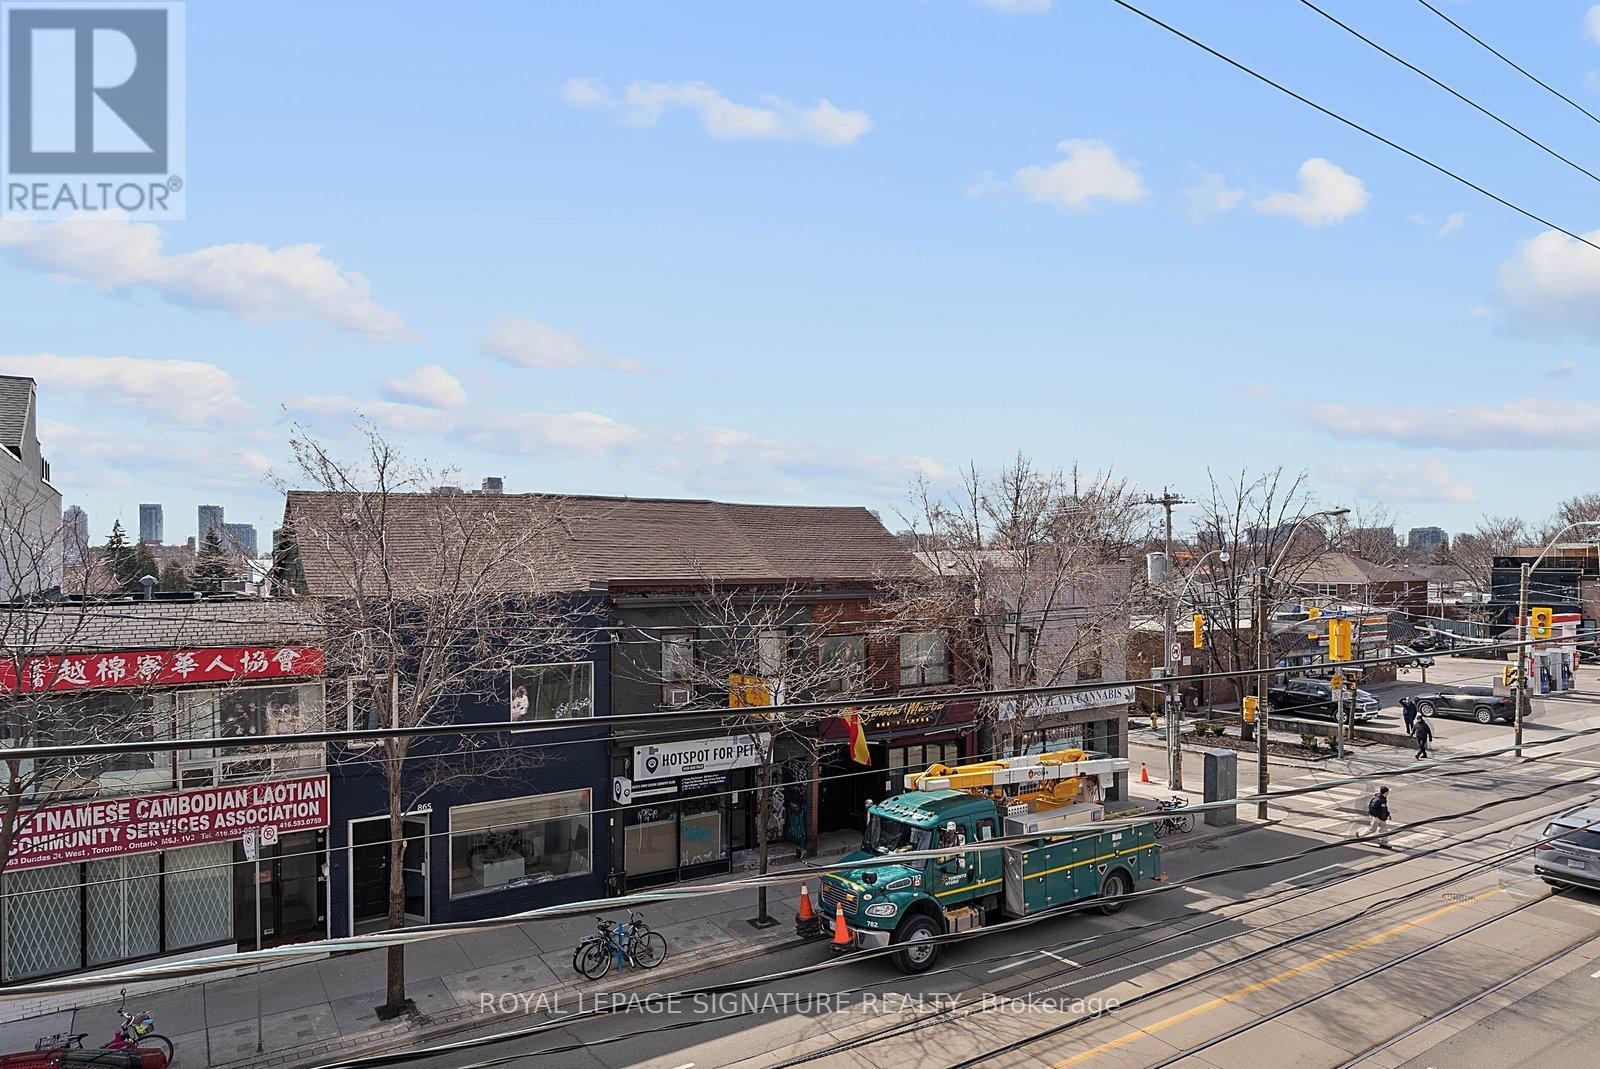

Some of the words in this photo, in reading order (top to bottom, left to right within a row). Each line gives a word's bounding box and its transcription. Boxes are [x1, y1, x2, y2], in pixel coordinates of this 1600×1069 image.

[662, 749, 710, 767] HOTSPOT
[713, 745, 733, 760] FOR
[136, 789, 247, 819] CAMBODIAN
[253, 780, 326, 806] LAOTIAN
[417, 803, 432, 811] 865
[126, 815, 210, 841] SERVICES
[214, 801, 320, 829] ASSOCIATION
[20, 855, 51, 864] Dundas
[866, 920, 878, 928] 782
